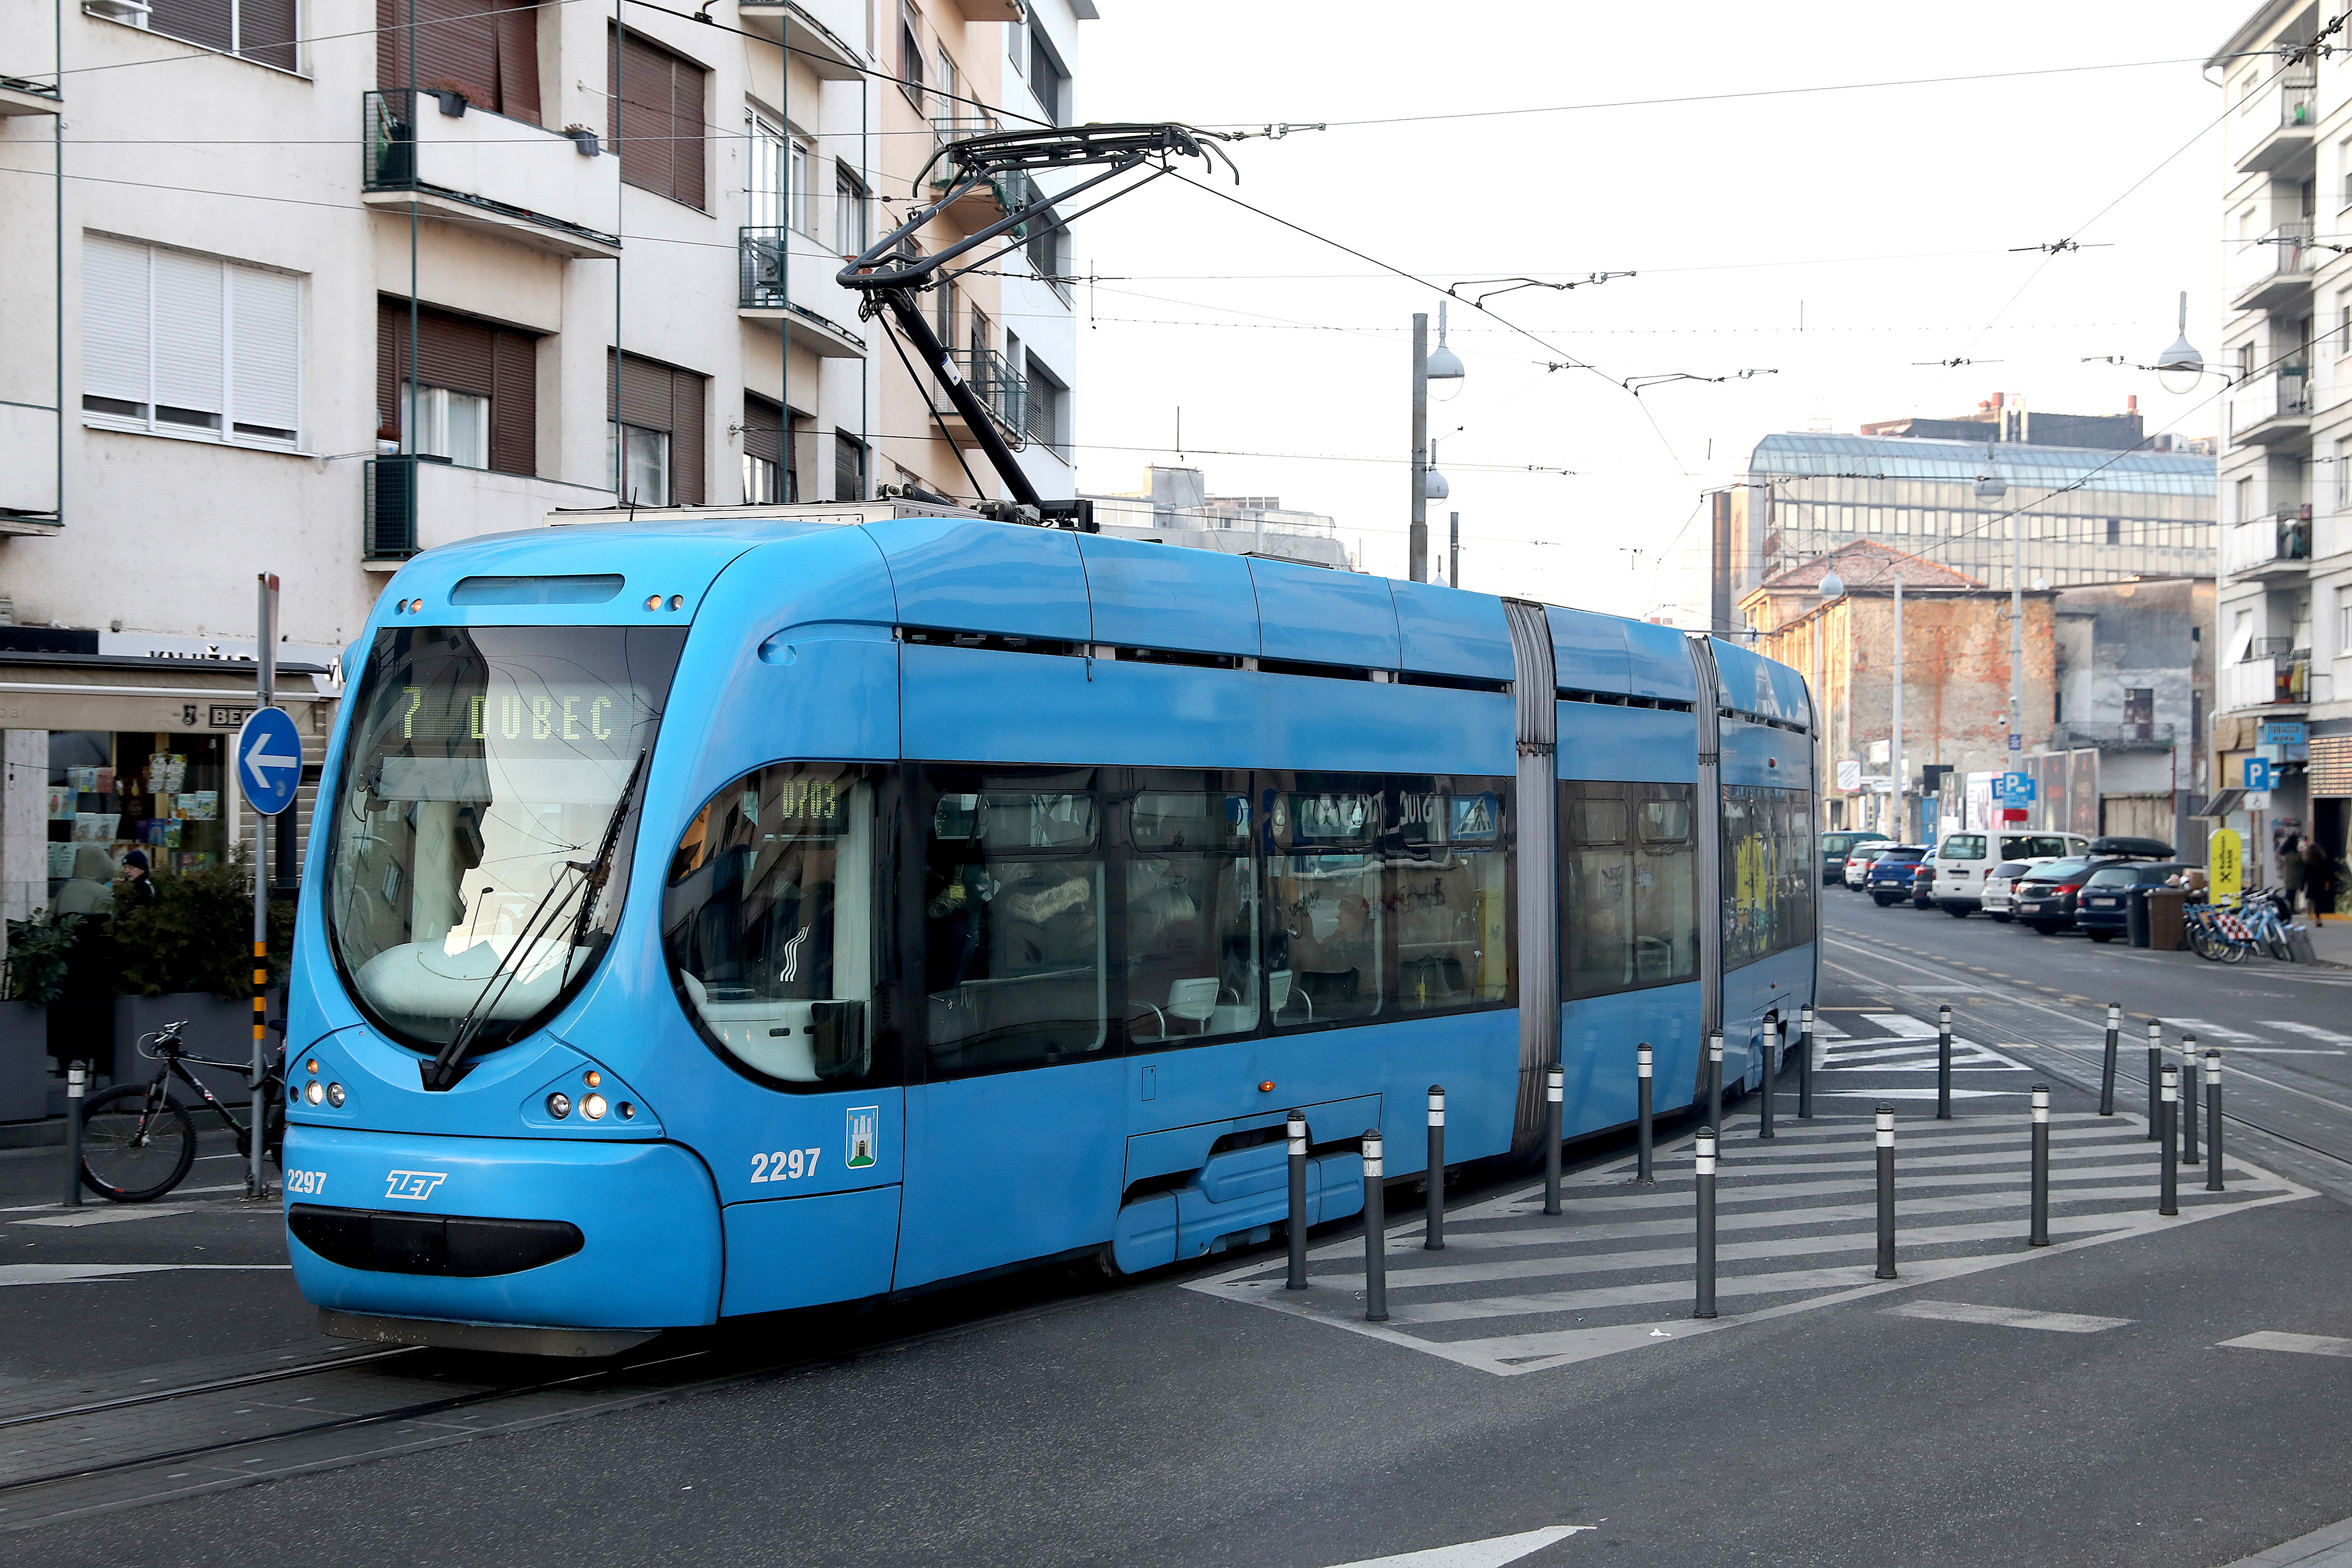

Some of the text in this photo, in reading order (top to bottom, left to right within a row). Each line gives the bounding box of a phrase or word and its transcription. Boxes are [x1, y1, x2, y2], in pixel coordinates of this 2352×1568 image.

[403, 686, 612, 740] 7 DUBEC
[2250, 763, 2263, 786] P
[783, 780, 836, 818] 0703
[288, 1168, 327, 1195] 2297
[750, 1148, 821, 1183] 2297
[385, 1169, 449, 1201] ZET
